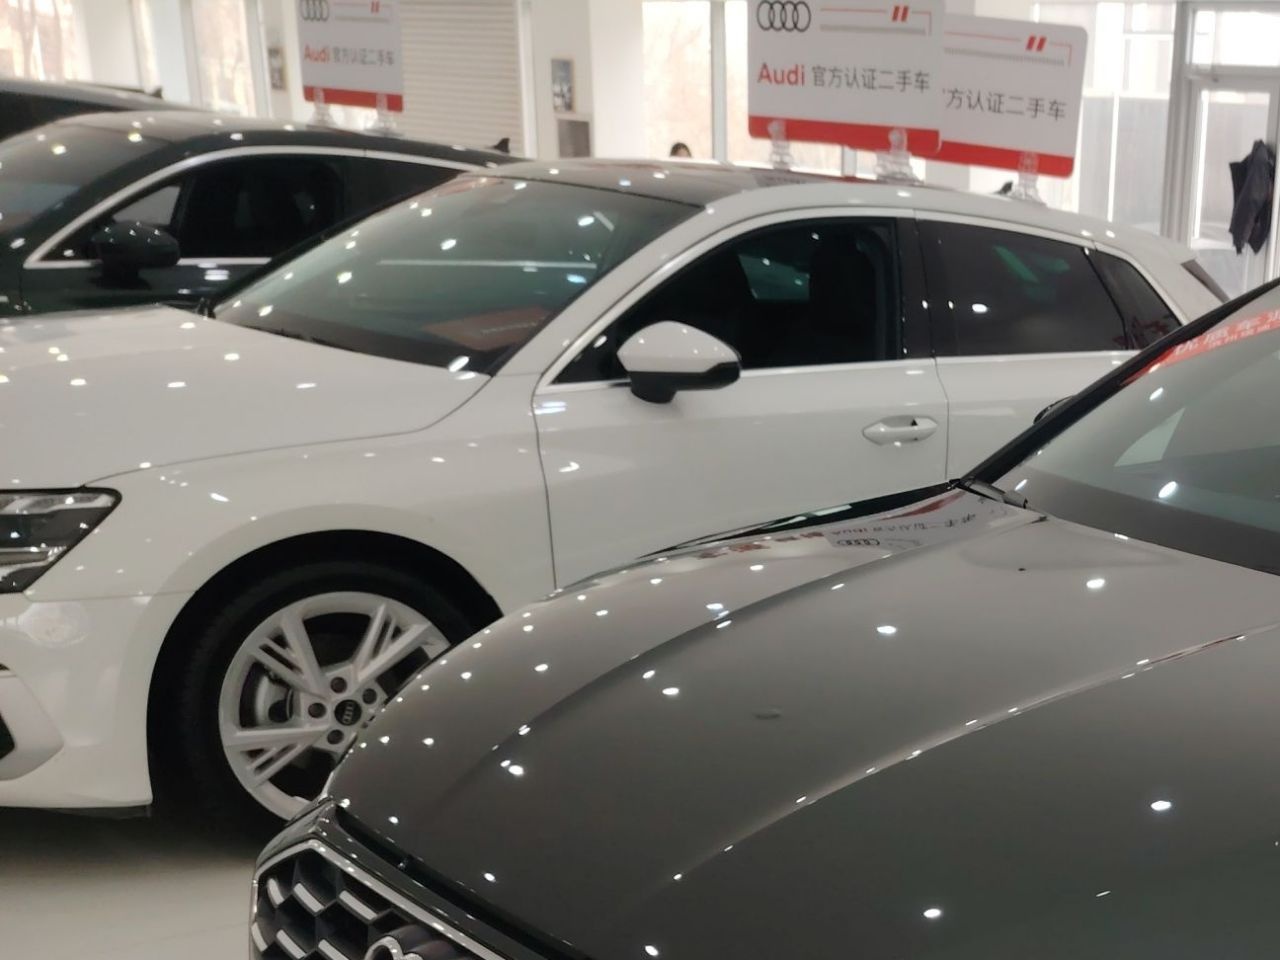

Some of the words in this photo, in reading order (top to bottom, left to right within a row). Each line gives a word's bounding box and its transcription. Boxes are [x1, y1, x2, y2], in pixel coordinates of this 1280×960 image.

[757, 62, 804, 86] Audi
[812, 66, 930, 93] 官方认证二手车
[942, 88, 1067, 121] 方认证二手车
